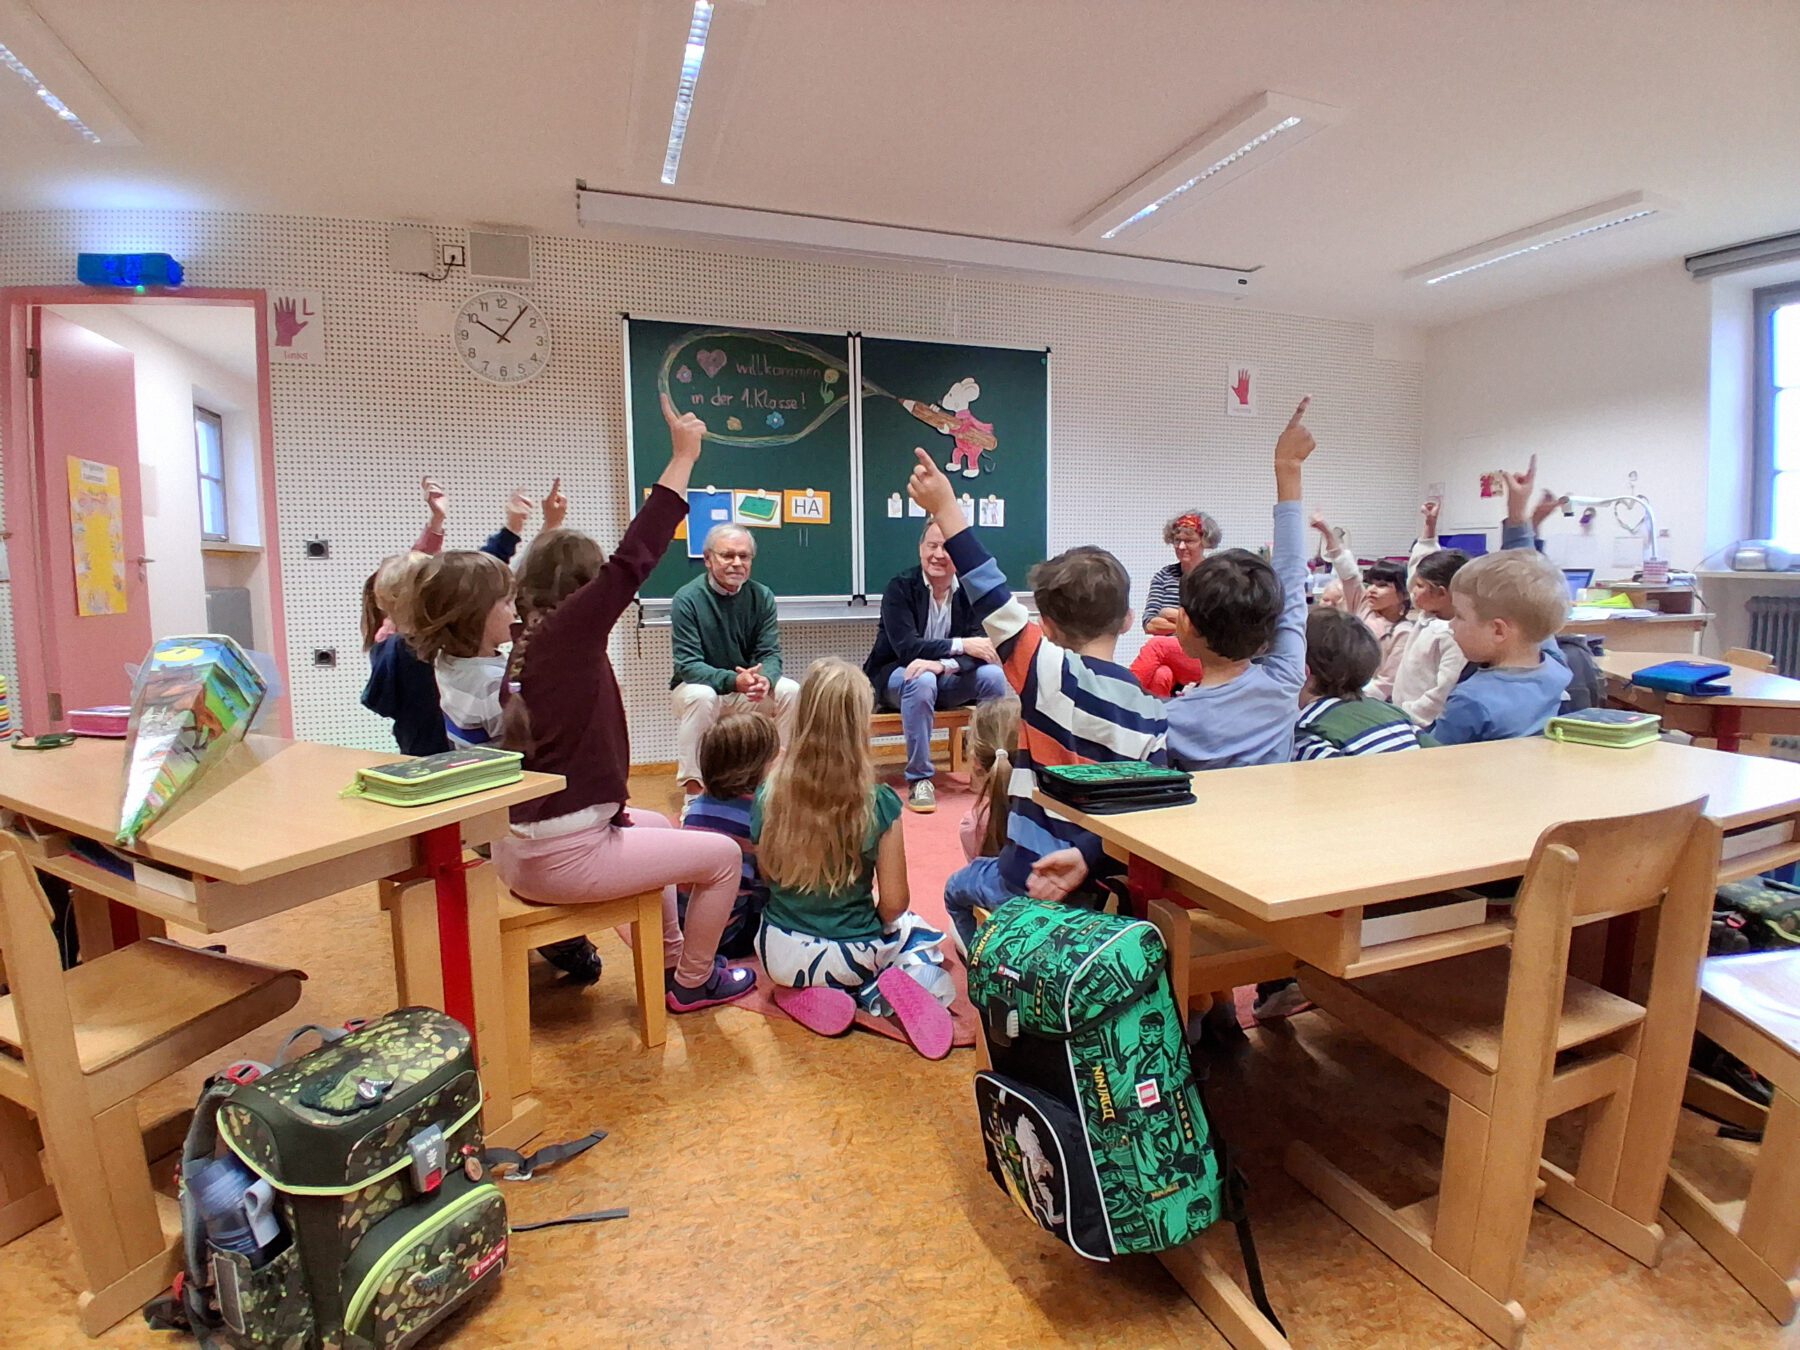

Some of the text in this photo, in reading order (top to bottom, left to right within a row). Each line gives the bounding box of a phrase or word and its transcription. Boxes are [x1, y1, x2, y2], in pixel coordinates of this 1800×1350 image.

[303, 297, 315, 315] L
[480, 301, 488, 312] 11
[496, 298, 508, 309] 12
[468, 312, 479, 323] 10
[529, 317, 537, 328] 2
[461, 329, 469, 340] 9
[536, 336, 544, 346] 3
[468, 347, 476, 358] 8
[530, 352, 537, 362] 4
[481, 361, 490, 371] 7
[500, 366, 507, 377] 6
[518, 363, 526, 374] 5
[710, 386, 734, 406] der
[794, 498, 820, 514] HA
[1092, 1065, 1116, 1122] NINJAGO
